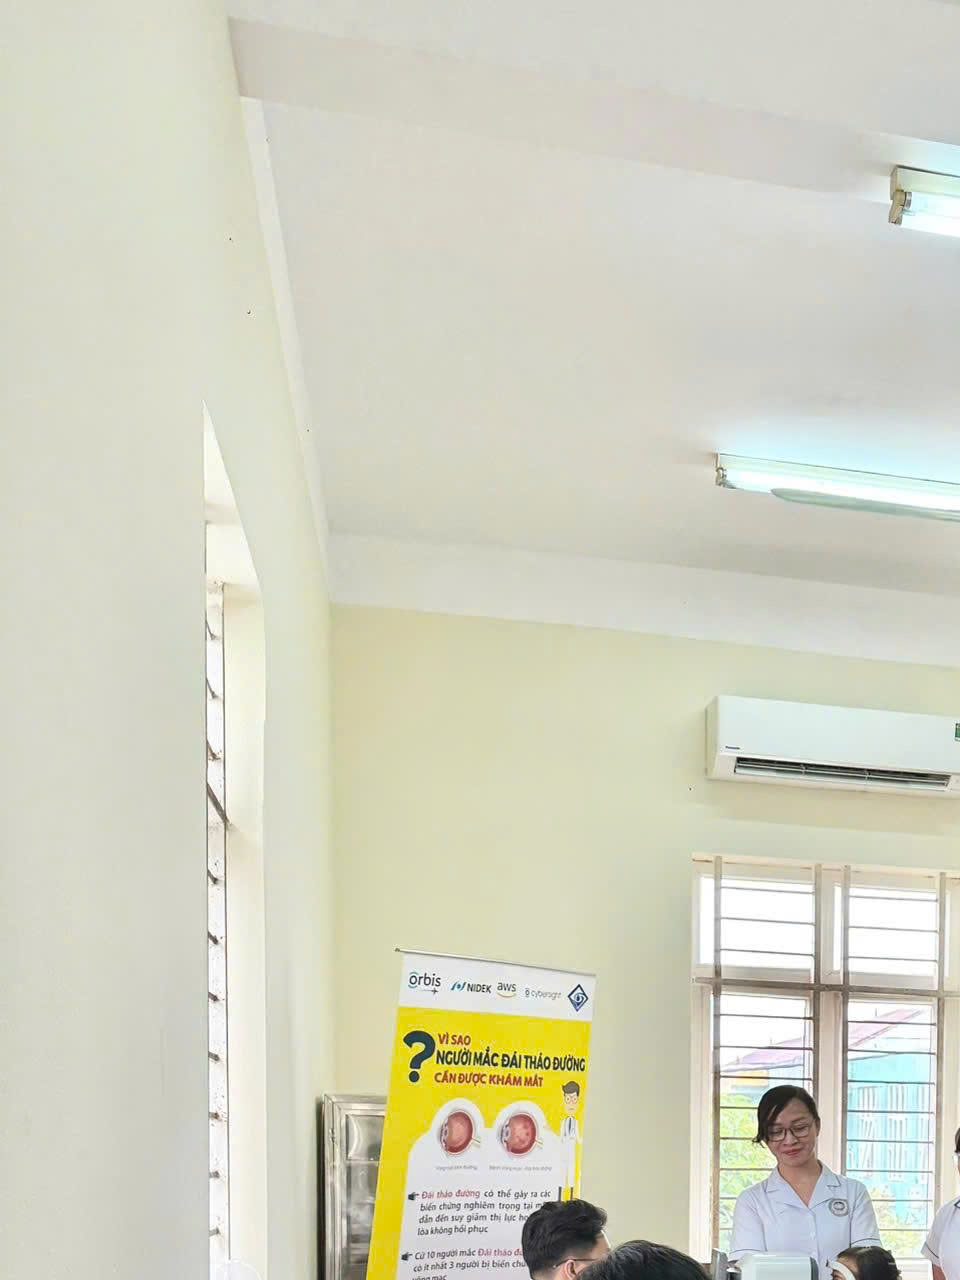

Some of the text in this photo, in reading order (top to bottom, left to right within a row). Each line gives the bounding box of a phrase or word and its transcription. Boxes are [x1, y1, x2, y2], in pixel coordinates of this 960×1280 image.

[408, 972, 441, 988] orbis
[467, 983, 492, 994] NIDEK
[497, 982, 517, 993] aws
[437, 1032, 471, 1046] VÌ SAO
[436, 1047, 472, 1065] NGƯỜI
[473, 1046, 499, 1067] MẮC
[501, 1051, 522, 1068] ĐÁI
[552, 1054, 585, 1072] ĐƯỜNG
[458, 1072, 487, 1086] ĐƯỢC
[427, 1251, 436, 1259] 10
